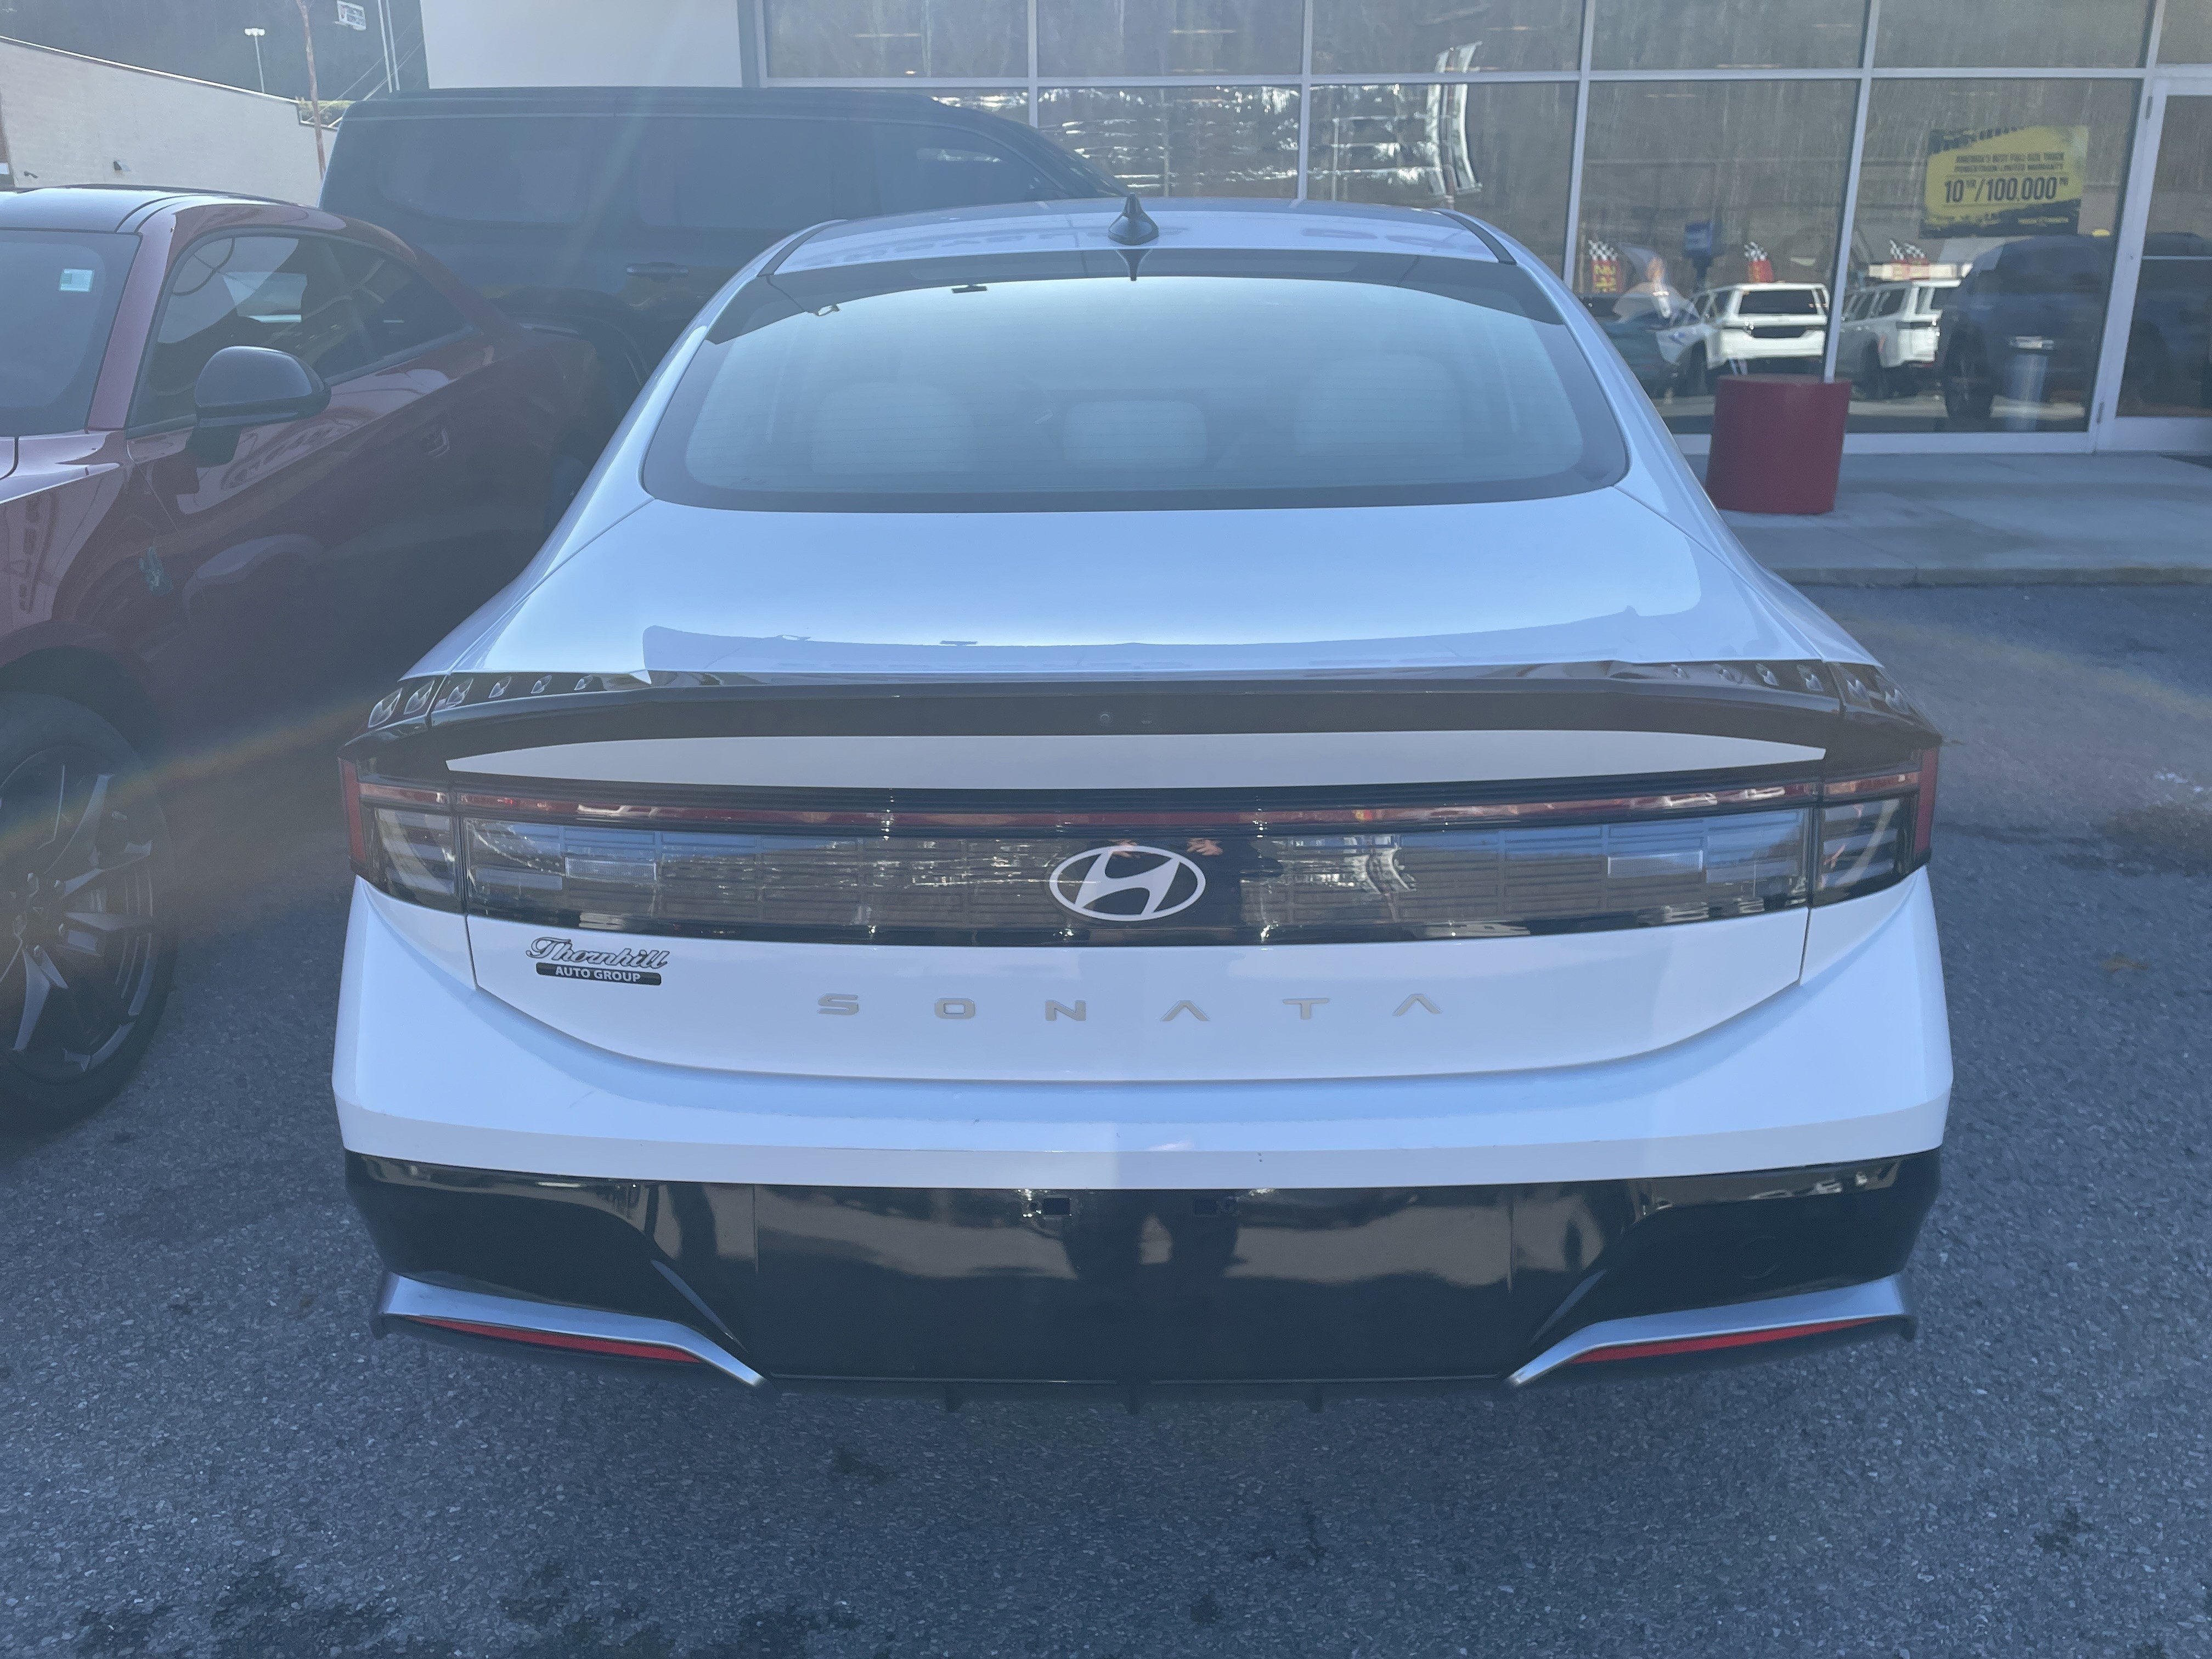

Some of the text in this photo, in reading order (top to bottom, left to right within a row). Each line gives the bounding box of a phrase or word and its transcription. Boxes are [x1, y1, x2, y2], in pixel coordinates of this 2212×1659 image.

[525, 936, 670, 969] Thornhill
[555, 966, 641, 983] AUTO GROUP
[816, 992, 1443, 1023] SONATA
